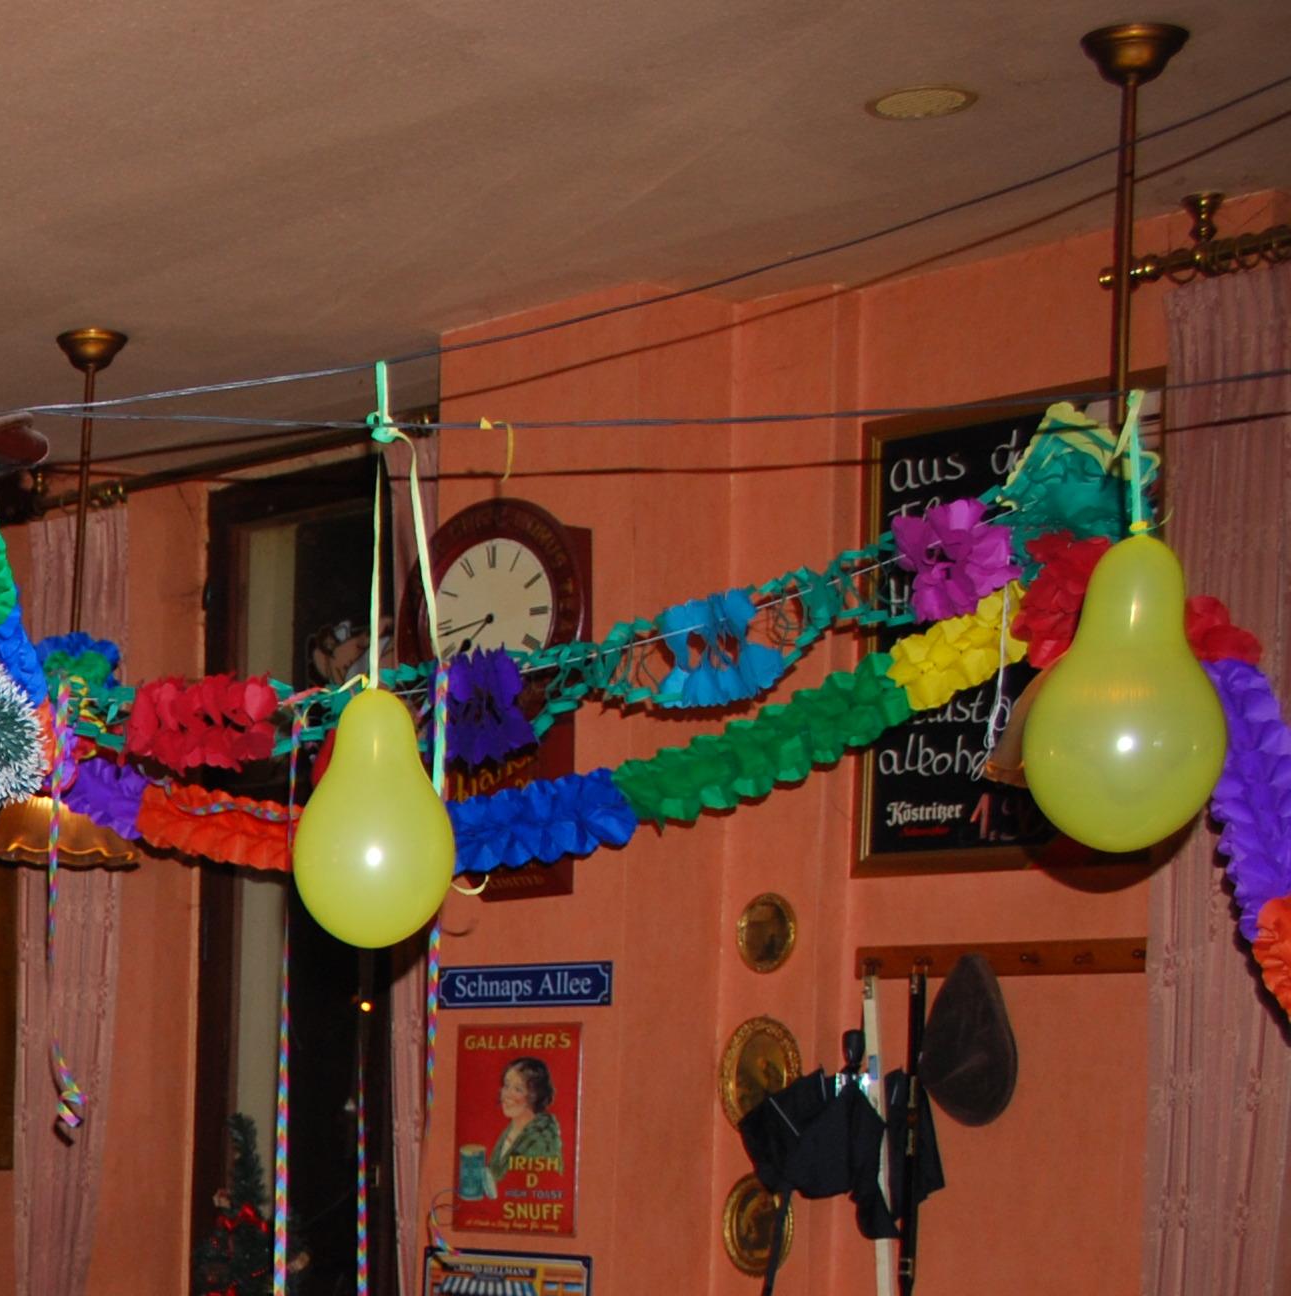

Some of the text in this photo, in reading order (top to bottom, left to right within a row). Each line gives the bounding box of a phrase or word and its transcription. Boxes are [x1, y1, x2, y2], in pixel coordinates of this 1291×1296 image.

[889, 451, 967, 493] aus
[454, 970, 593, 1003] Schnaps Allee
[508, 1154, 560, 1172] IRISH
[525, 1172, 539, 1189] D
[502, 1201, 564, 1221] SNUFF
